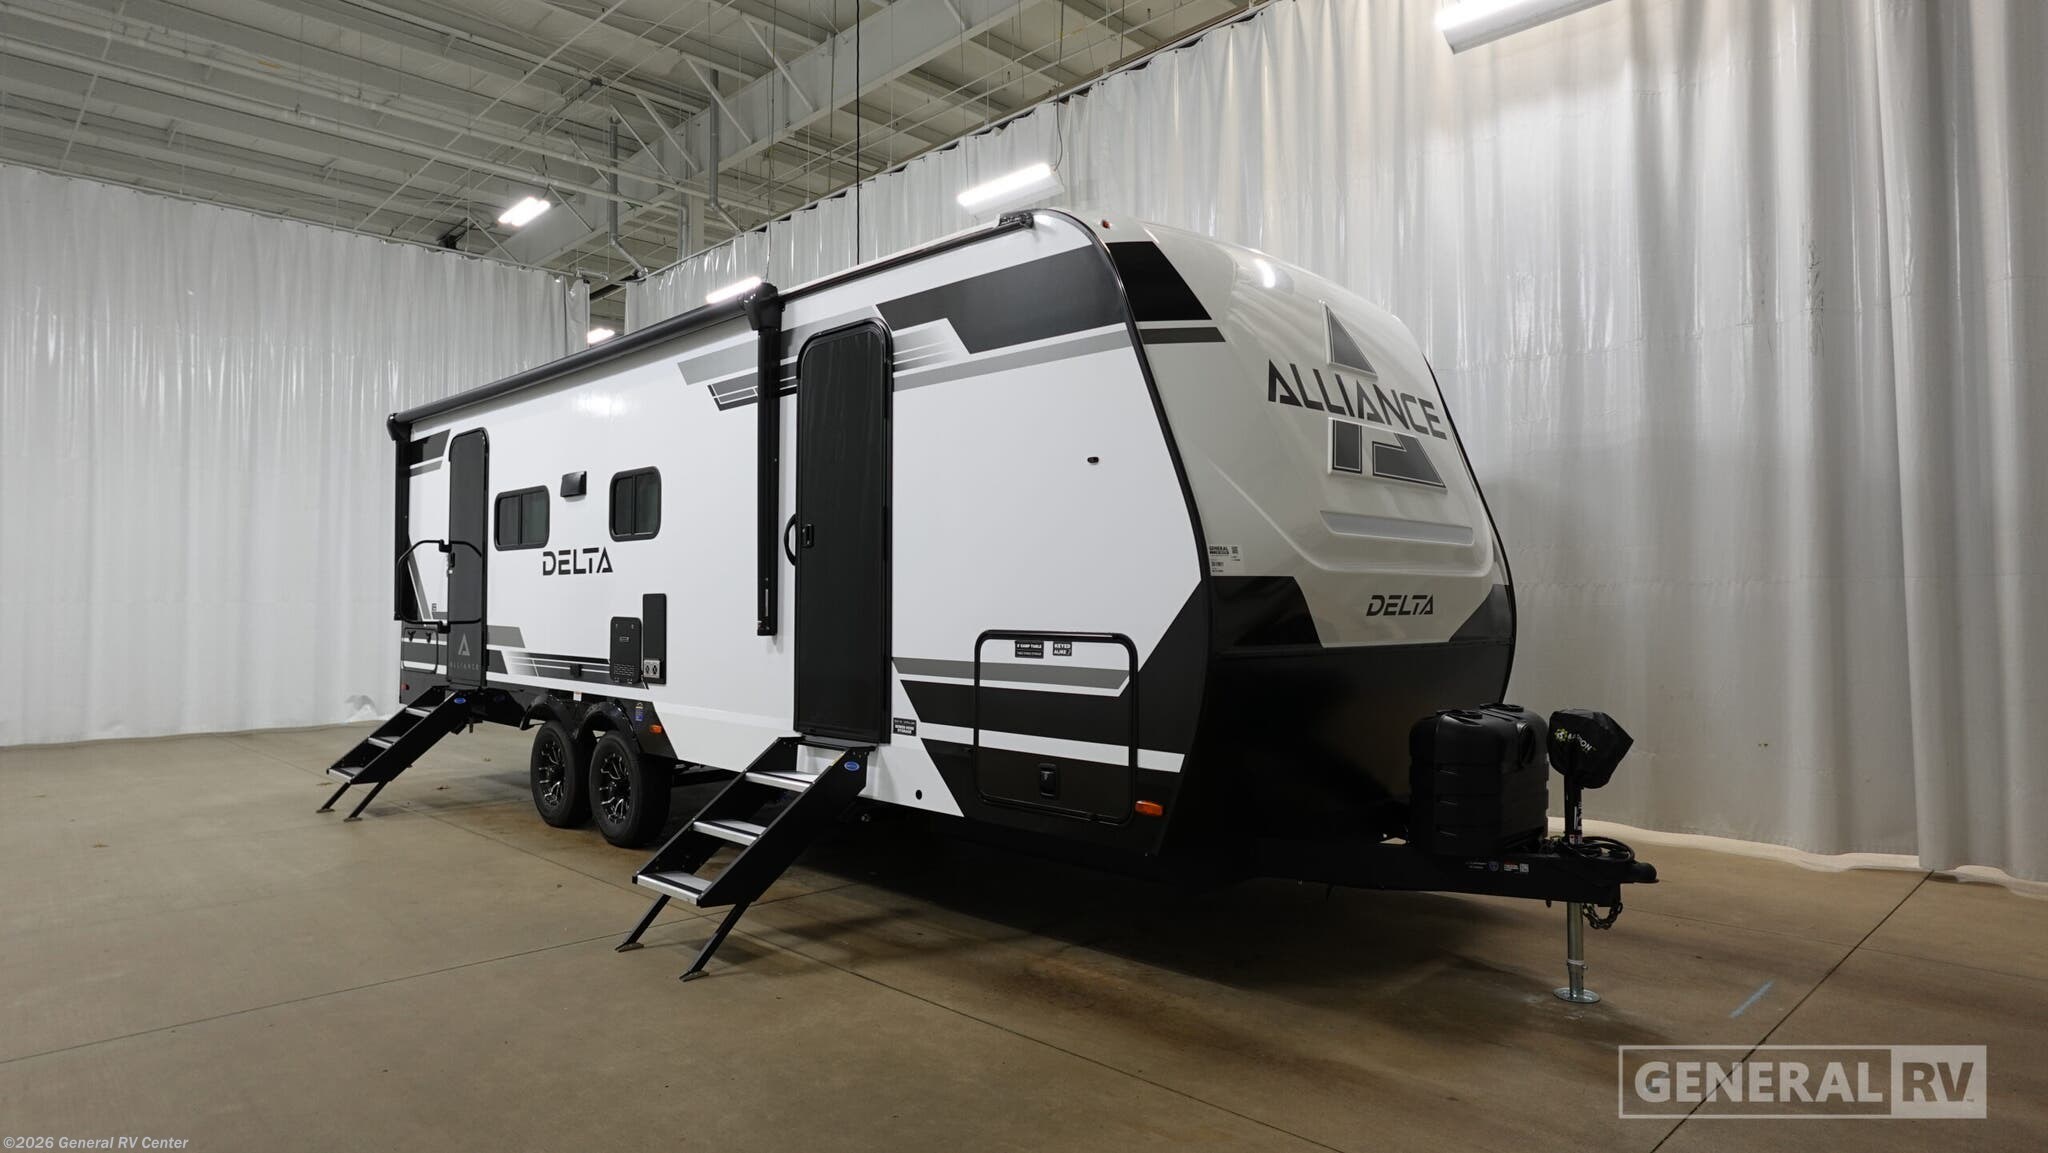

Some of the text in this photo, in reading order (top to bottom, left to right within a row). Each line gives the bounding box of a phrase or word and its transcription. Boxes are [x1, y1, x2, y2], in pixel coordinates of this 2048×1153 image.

[1268, 359, 1447, 440] ALLIANCE
[542, 547, 613, 575] DELTA
[1366, 594, 1434, 617] DELTA
